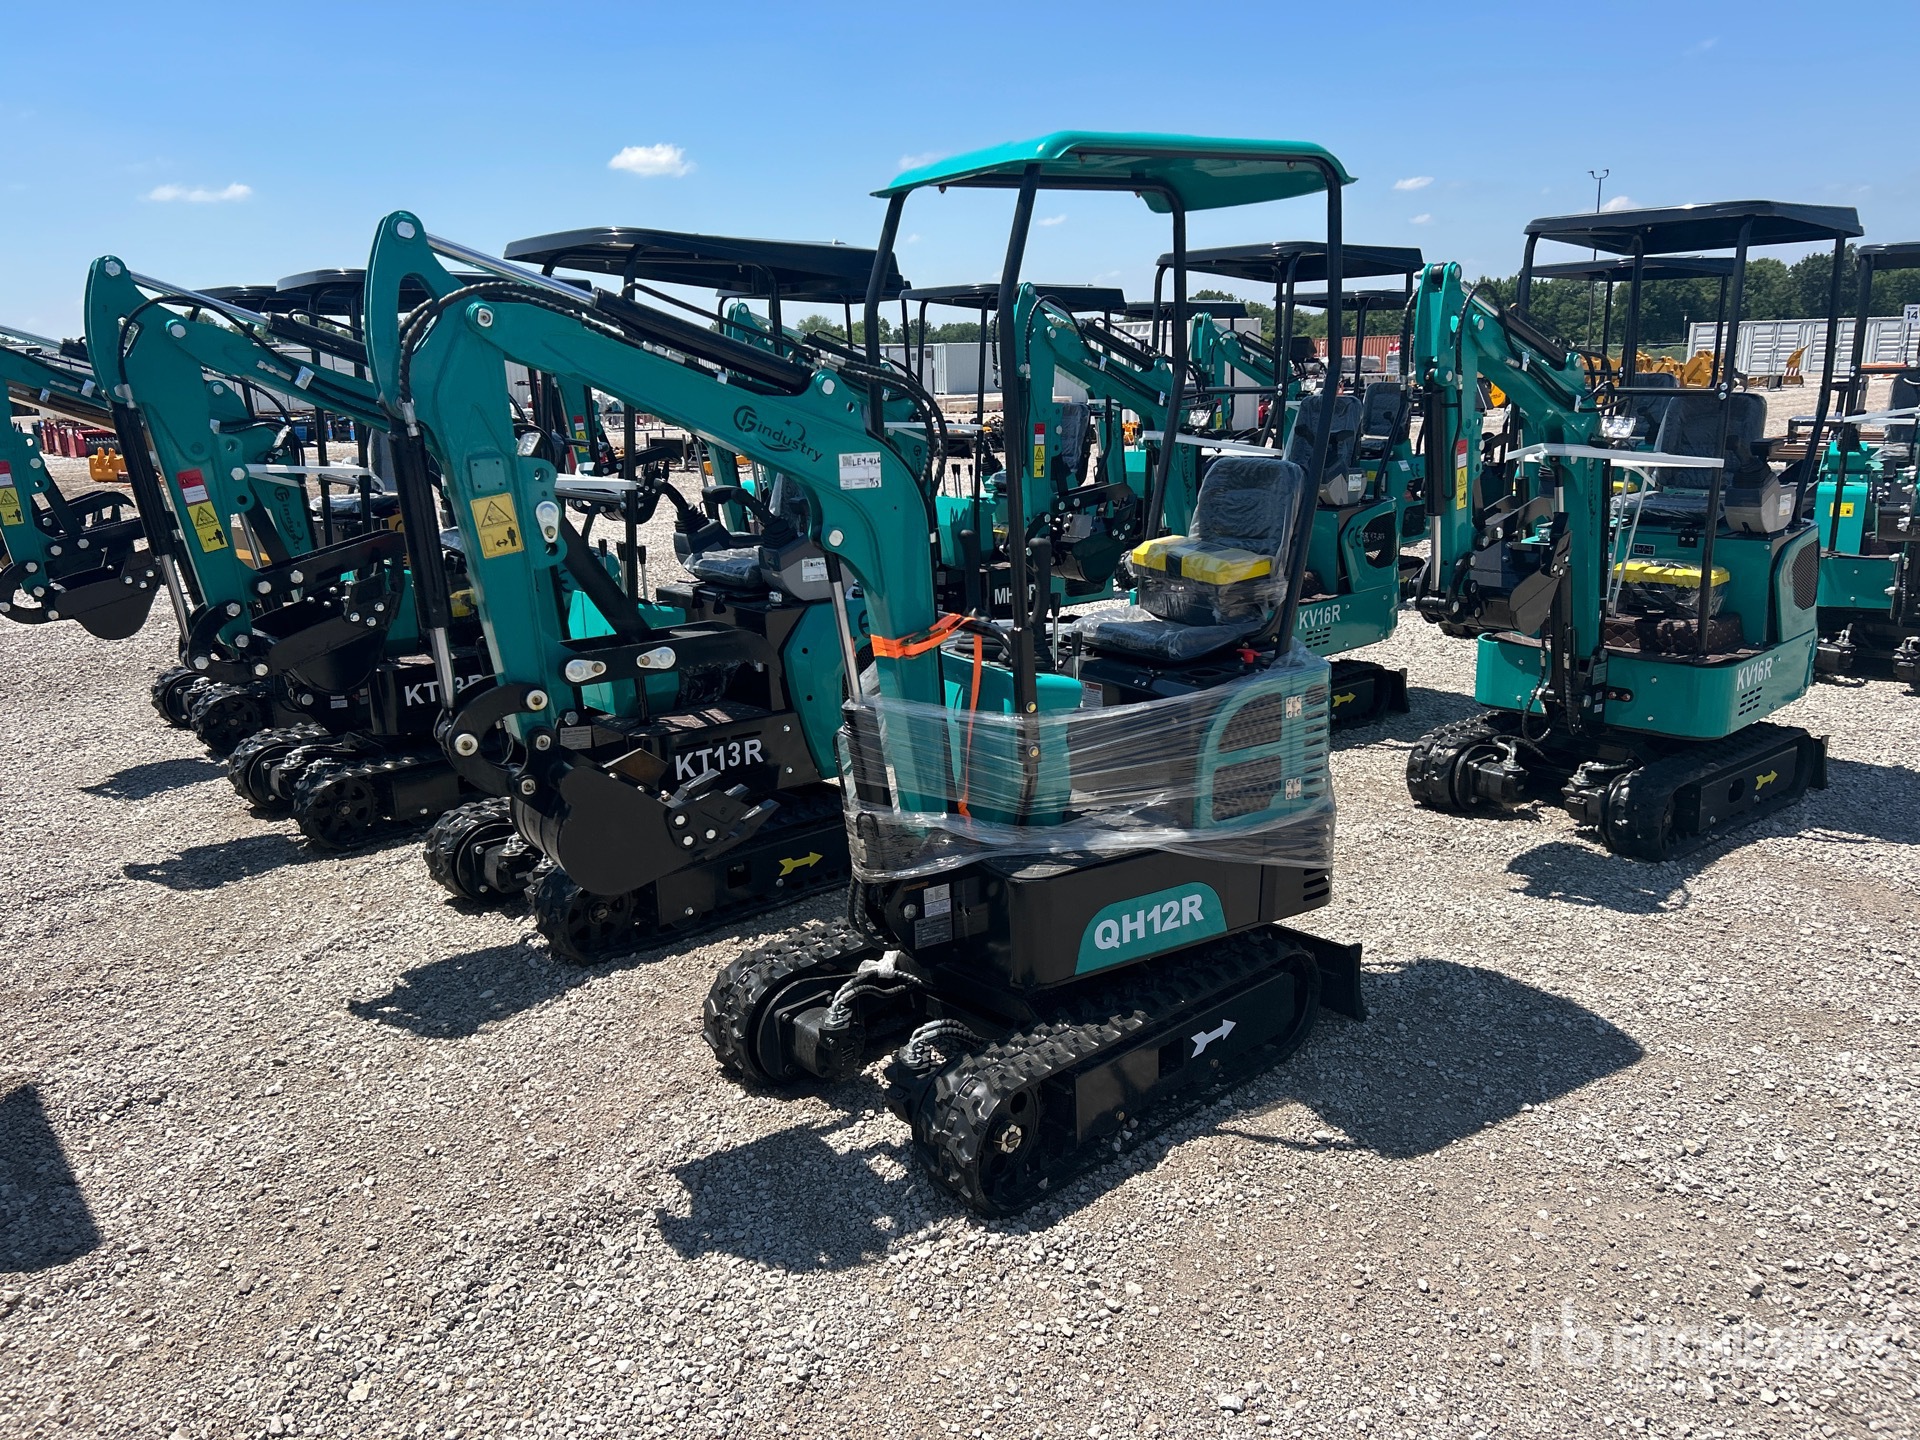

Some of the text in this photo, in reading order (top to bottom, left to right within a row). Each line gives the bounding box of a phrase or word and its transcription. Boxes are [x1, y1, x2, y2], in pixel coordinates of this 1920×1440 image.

[1906, 310, 1918, 320] 14
[1299, 604, 1341, 630] KV16R
[1736, 657, 1773, 692] KV16R
[675, 739, 764, 781] KT13R
[1094, 893, 1204, 950] QH12R
